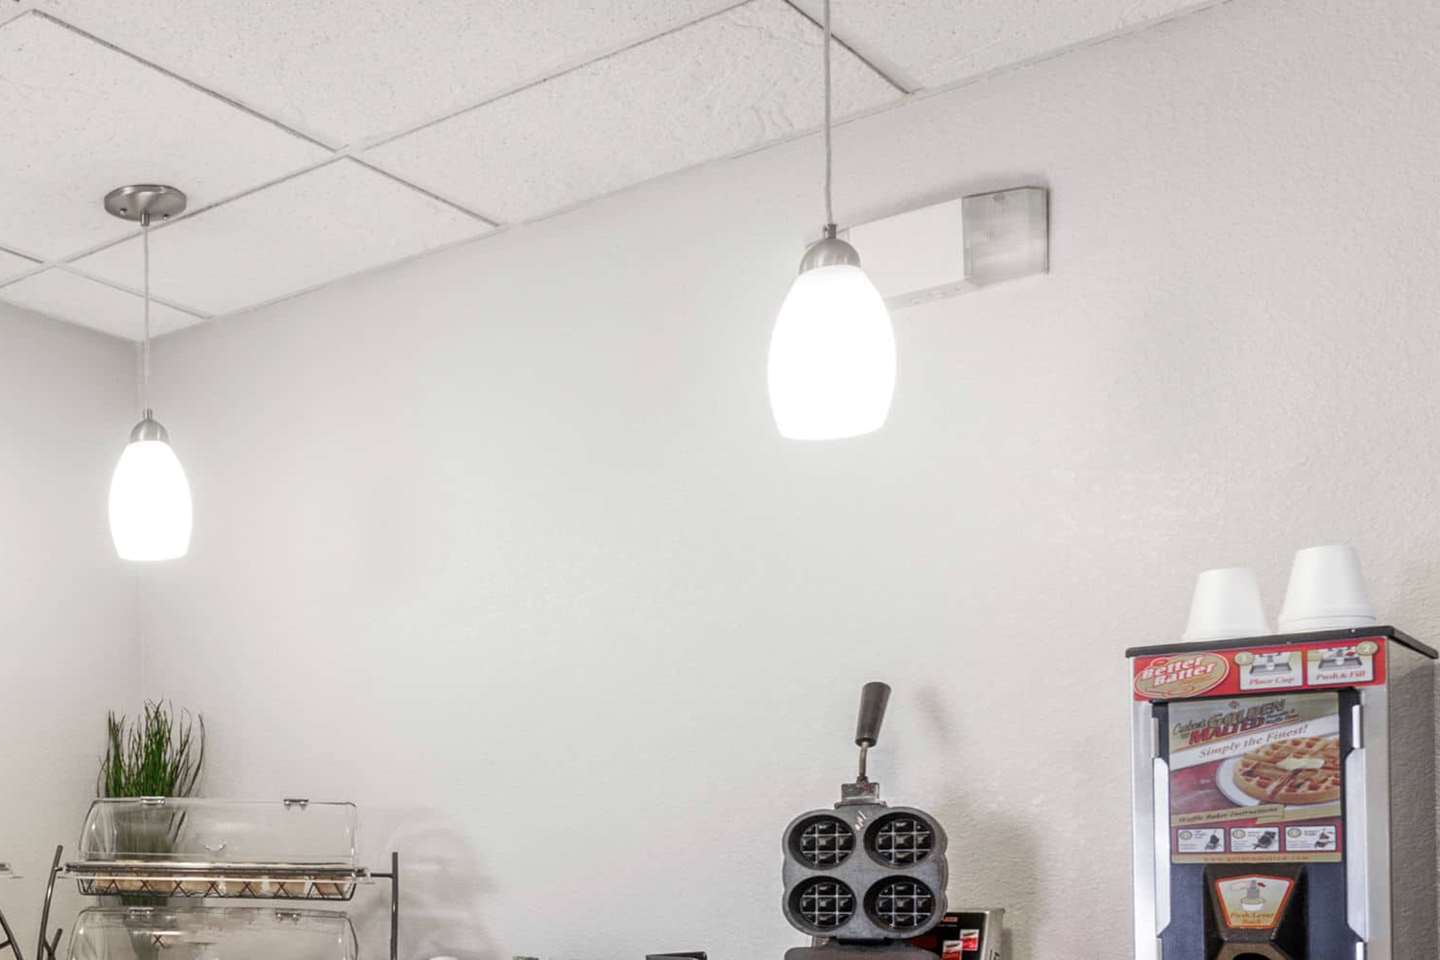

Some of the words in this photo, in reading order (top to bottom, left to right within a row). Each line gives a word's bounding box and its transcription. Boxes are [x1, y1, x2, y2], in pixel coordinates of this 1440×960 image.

[1189, 716, 1265, 745] MALTED
[1198, 740, 1242, 759] Simply
[1244, 735, 1263, 748] the
[1266, 724, 1309, 742] Finest!
